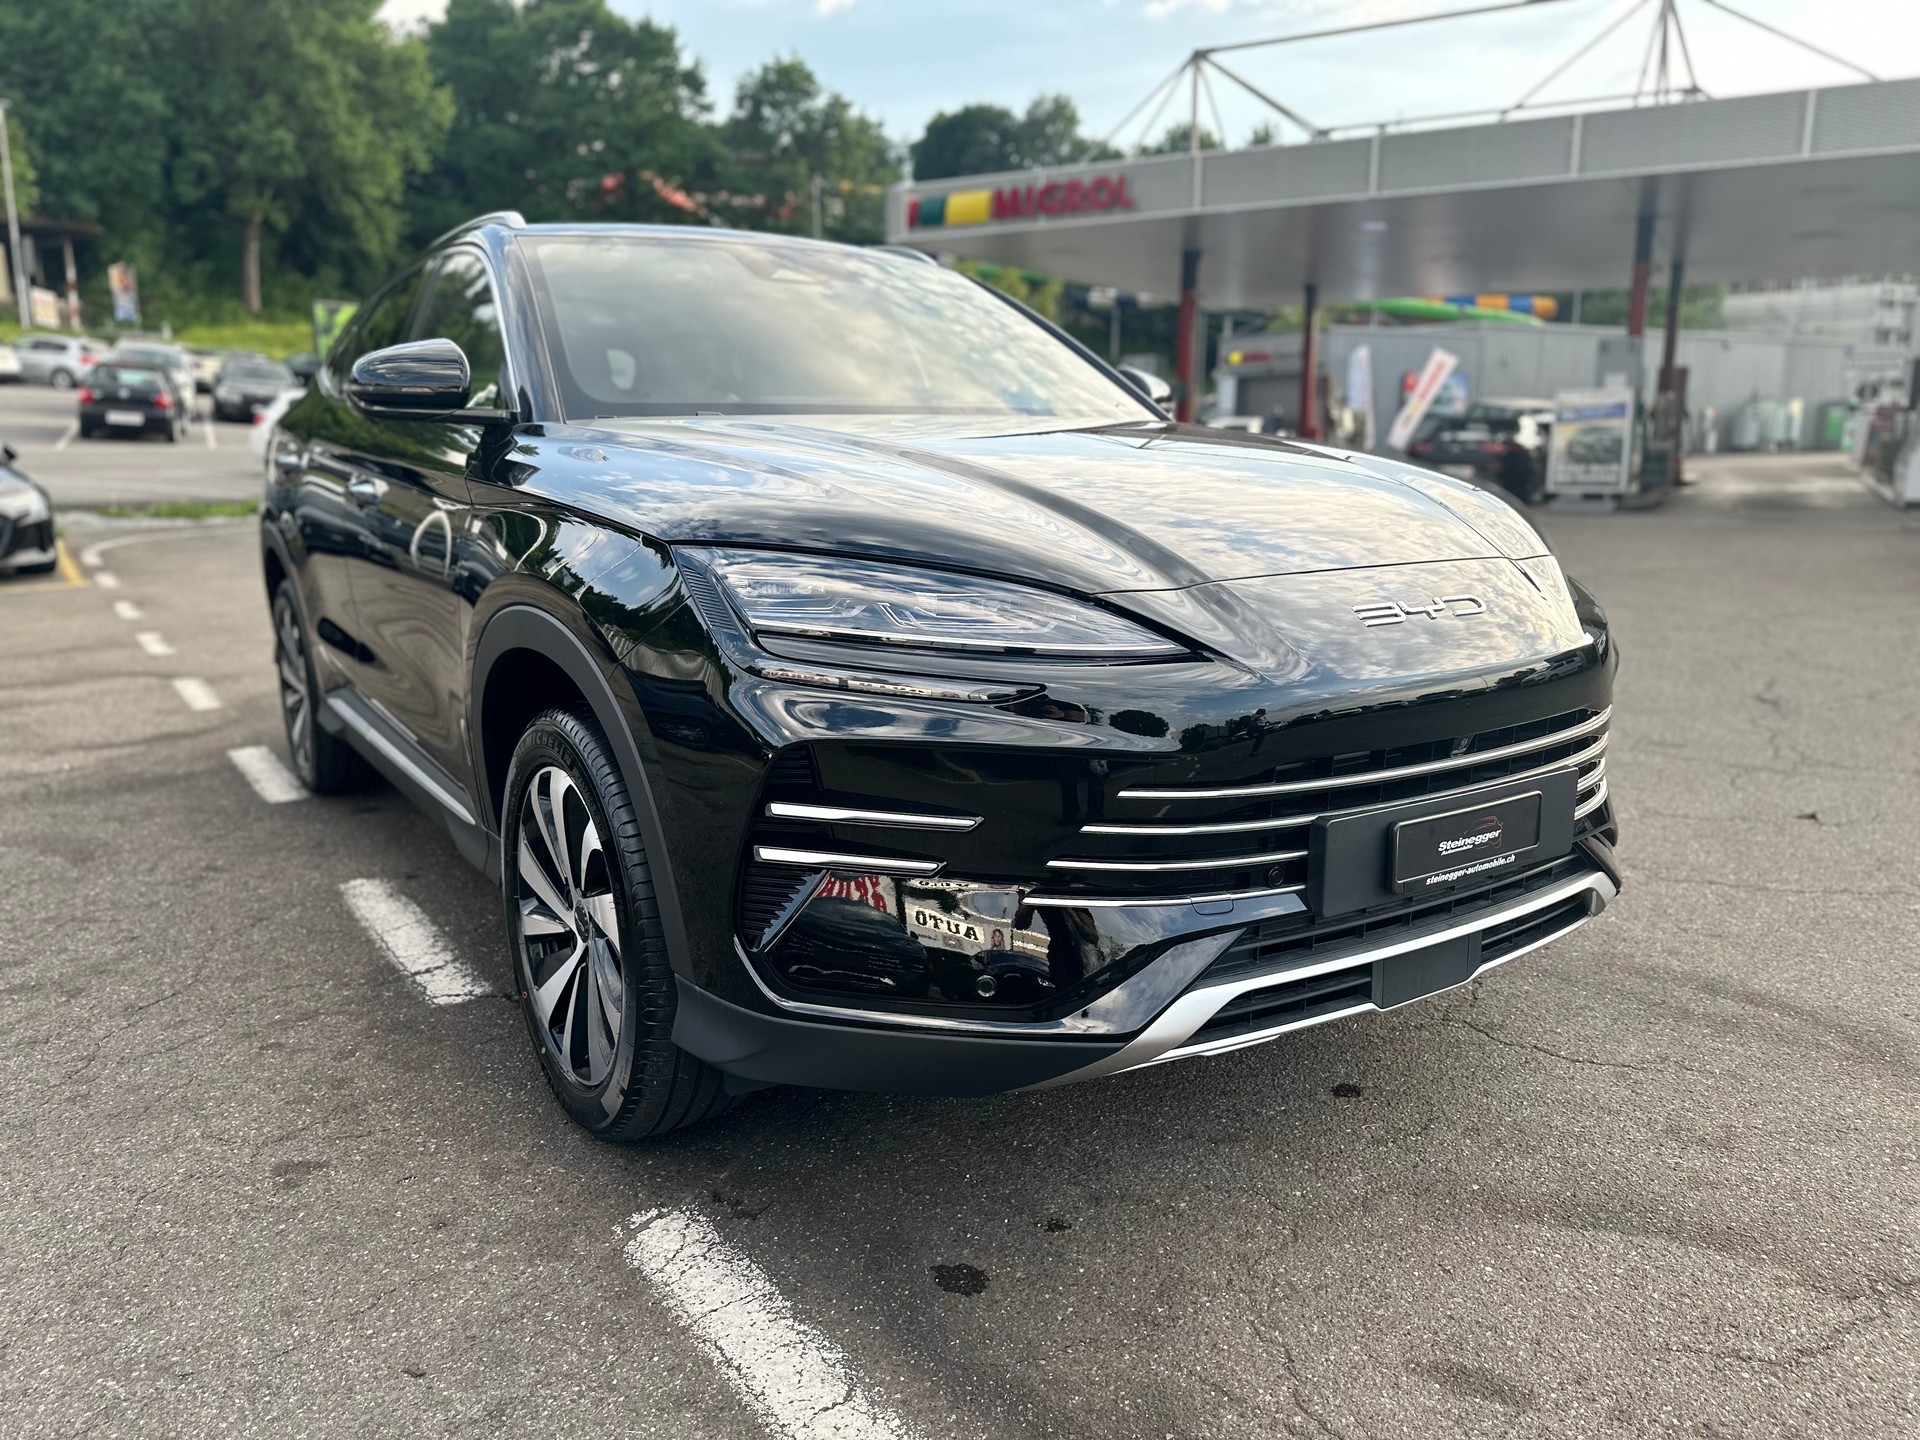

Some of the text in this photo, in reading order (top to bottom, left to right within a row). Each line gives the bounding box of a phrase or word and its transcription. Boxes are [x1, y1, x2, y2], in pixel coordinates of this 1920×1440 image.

[992, 174, 1134, 220] MIGROL
[1351, 594, 1487, 628] BYD
[525, 732, 574, 765] MICHELIN
[1438, 829, 1502, 852] Steinegger
[1426, 853, 1516, 886] steinegger-automobile.ch
